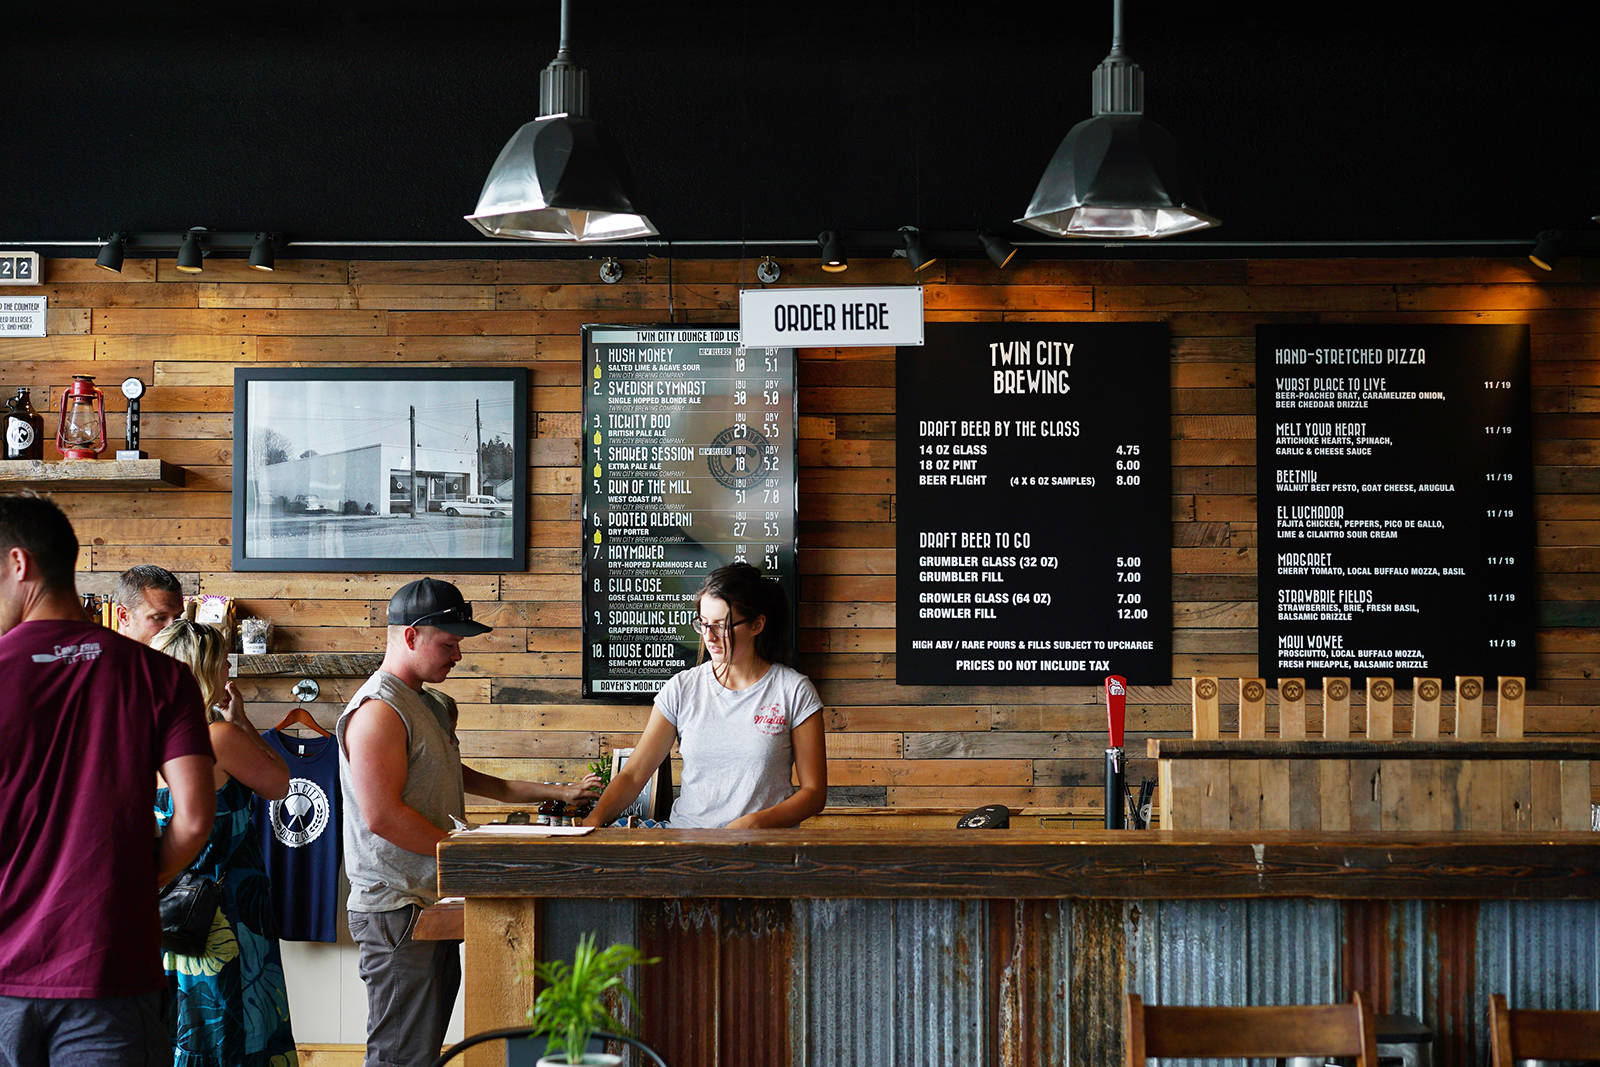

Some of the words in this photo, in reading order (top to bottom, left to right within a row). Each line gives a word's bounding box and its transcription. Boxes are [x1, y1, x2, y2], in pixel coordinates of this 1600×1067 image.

[774, 304, 836, 332] ORDER
[842, 302, 889, 330] HERE
[636, 331, 656, 342] TWIN
[657, 331, 675, 342] CITY
[677, 331, 707, 342] LOUNGE
[708, 331, 725, 342] TAP
[726, 331, 740, 342] LIS
[595, 348, 601, 362] 1.
[608, 348, 635, 362] HUSH
[638, 348, 674, 363] MONEY
[989, 341, 1030, 366] TWIN
[1036, 340, 1074, 366] CITY
[1276, 348, 1382, 364] HAND-STRETCHED
[1387, 348, 1426, 364] PIZZA
[608, 364, 633, 372] SALTED
[634, 364, 650, 372] LIME
[652, 364, 658, 372] &
[658, 364, 680, 372] AGAVE
[682, 364, 700, 372] SOUR
[594, 381, 602, 395] 2.
[608, 380, 654, 396] SWEDISH
[657, 380, 706, 395] GYMNAST
[994, 370, 1070, 394] BREWING
[1276, 378, 1310, 391] WURST
[1314, 378, 1344, 391] PLACE
[1348, 378, 1360, 391] TO
[1364, 378, 1386, 391] LIVE
[1484, 381, 1493, 389] 11
[1501, 381, 1511, 389] 19
[594, 414, 602, 428] 3.
[608, 414, 647, 428] TICKITY
[650, 414, 671, 428] BOO
[920, 420, 957, 436] DRAFT
[961, 421, 990, 436] BEER
[994, 421, 1010, 436] BY
[1015, 421, 1036, 436] THE
[1041, 420, 1080, 437] GLASS
[1276, 423, 1301, 436] MELT
[1305, 422, 1332, 436] YOUR
[1335, 422, 1366, 436] HEART
[594, 446, 602, 461] 4.
[608, 446, 648, 461] SHAKER
[651, 446, 694, 461] SESSION
[920, 445, 933, 455] 14
[936, 444, 950, 455] OZ
[953, 444, 987, 455] GLASS
[1116, 445, 1140, 455] 4.75
[920, 460, 933, 470] 18
[936, 460, 950, 470] OZ
[953, 460, 978, 470] PINT
[1116, 460, 1140, 470] 6.00
[919, 475, 947, 485] BEER
[950, 475, 987, 485] FLIGHT
[1010, 476, 1019, 487] (4
[1022, 477, 1028, 485] X
[1030, 477, 1036, 486] 6
[1038, 476, 1049, 486] OZ
[1051, 476, 1095, 487] SAMPLES)
[1116, 475, 1140, 486] 8.00
[1276, 470, 1317, 483] BEETNIK
[594, 480, 602, 494] 5.
[608, 480, 628, 494] RUN
[632, 480, 644, 494] OF
[648, 479, 666, 494] THE
[669, 480, 692, 494] MILL
[1276, 484, 1308, 492] WALNUT
[1310, 484, 1330, 492] BEET
[1332, 484, 1359, 493] PESTO,
[1362, 484, 1382, 492] GOAT
[1384, 484, 1416, 493] CHEESE,
[1418, 484, 1455, 492] ARUGULA
[594, 512, 602, 526] 6.
[608, 512, 647, 526] PORTER
[650, 512, 692, 526] ALBERNI
[1277, 506, 1289, 519] EL
[1292, 506, 1344, 519] LUCHADOR
[920, 532, 957, 548] DRAFT
[962, 532, 991, 548] BEER
[995, 532, 1010, 548] TO
[1014, 532, 1030, 548] GO
[593, 545, 603, 559] 7.
[608, 545, 664, 560] HAYMAKER
[1278, 552, 1332, 566] MARGARET
[919, 556, 978, 567] GRUMBLER
[982, 556, 1016, 567] GLASS
[1019, 556, 1037, 569] (32
[1040, 556, 1058, 569] OZ)
[1117, 557, 1141, 567] 5.00
[919, 571, 978, 582] GRUMBLER
[982, 572, 1004, 582] FILL
[1117, 572, 1141, 582] 7.00
[1278, 566, 1309, 575] CHERRY
[1310, 567, 1345, 576] TOMATO,
[1347, 567, 1372, 575] LOCAL
[1411, 568, 1440, 576] MOZZA,
[594, 578, 602, 592] 8.
[609, 578, 632, 592] GILA
[635, 578, 662, 592] GOSE
[919, 592, 971, 603] GROWLER
[974, 593, 1009, 604] GLASS
[1012, 593, 1030, 606] (64
[1033, 593, 1051, 606] OZ)
[1117, 594, 1141, 604] 7.00
[1278, 589, 1336, 603] STRAWBRIE
[1339, 590, 1372, 603] FIELDS
[919, 608, 971, 618] GROWLER
[974, 608, 997, 618] FILL
[1118, 608, 1148, 619] 12.00
[912, 640, 933, 649] HIGH
[935, 640, 953, 649] ABV
[955, 640, 960, 649] /
[962, 640, 985, 649] RARE
[987, 640, 1016, 649] POURS
[1018, 640, 1026, 649] &
[1028, 640, 1051, 650] FILLS
[1053, 640, 1092, 650] SUBJECT
[1094, 641, 1105, 650] TO
[1107, 641, 1154, 650] UPCHARGE
[1278, 635, 1304, 649] MAUI
[1307, 635, 1343, 649] WOWEE
[592, 644, 605, 658] 10.
[609, 644, 642, 658] HOUSE
[645, 644, 674, 658] CIDER
[956, 660, 995, 670] PRICES
[998, 660, 1013, 670] DO
[1016, 660, 1038, 671] NOT
[1040, 660, 1086, 671] INCLUDE
[1088, 660, 1110, 671] TAX
[1278, 660, 1304, 668] FRESH
[1306, 660, 1352, 670] PINEAPPLE,
[1354, 660, 1394, 668] BALSAMIC
[1396, 660, 1428, 668] DRIZZLE
[600, 681, 632, 691] RAVEN'S
[633, 681, 653, 691] MOON
[302, 784, 321, 802] CITY
